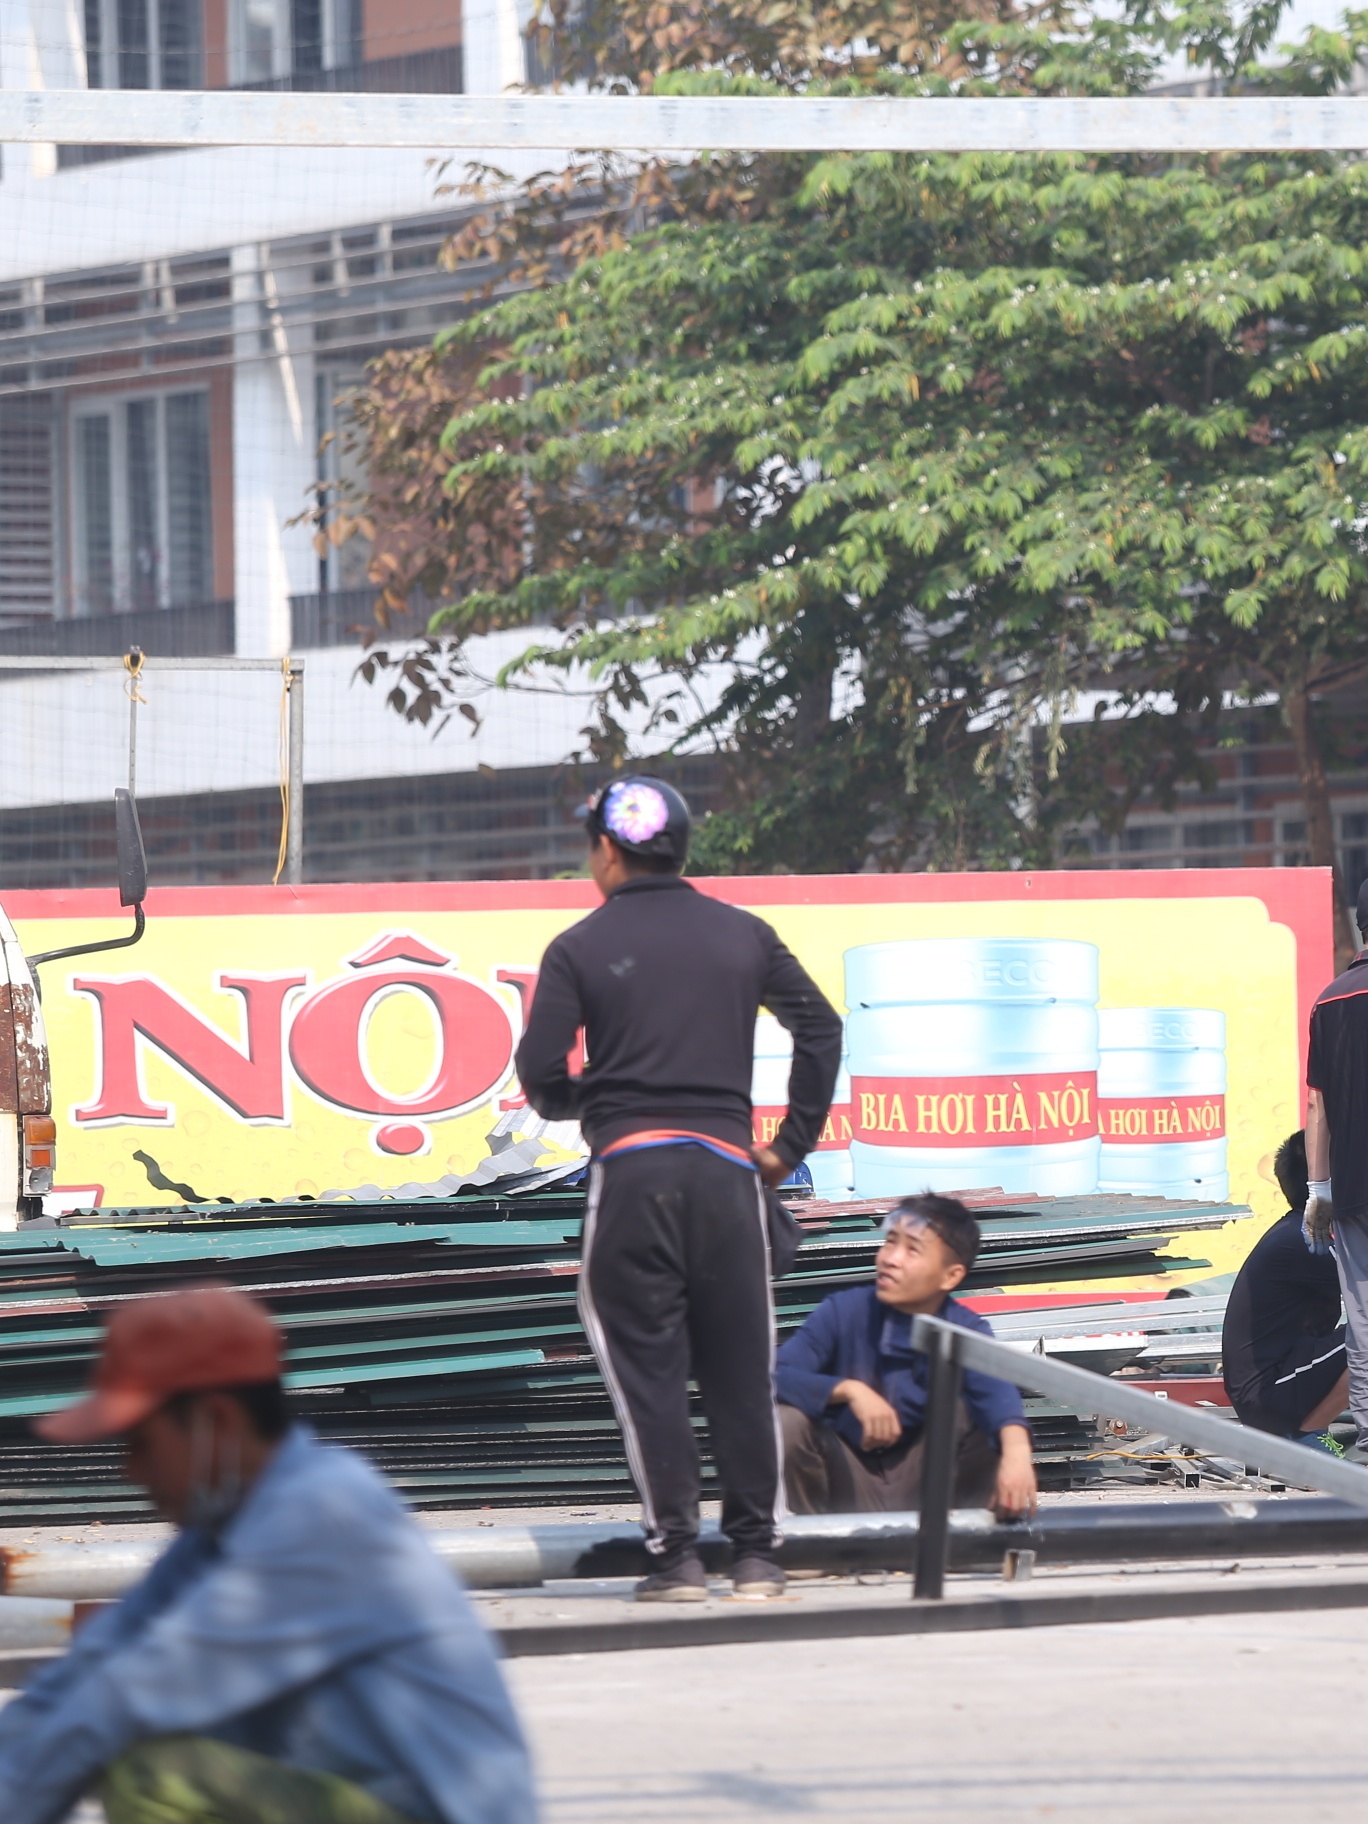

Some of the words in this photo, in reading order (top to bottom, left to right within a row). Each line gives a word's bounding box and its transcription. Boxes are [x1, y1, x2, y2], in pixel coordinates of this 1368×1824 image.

[72, 929, 584, 1156] NỘ
[859, 1092, 908, 1133] BIA
[915, 1092, 976, 1135] HƠI
[984, 1081, 1032, 1134] HÀ
[1037, 1079, 1091, 1137] NỘI
[1108, 1107, 1149, 1136] HƠI
[1152, 1100, 1184, 1135] HÀ
[1186, 1099, 1222, 1137] NỘI
